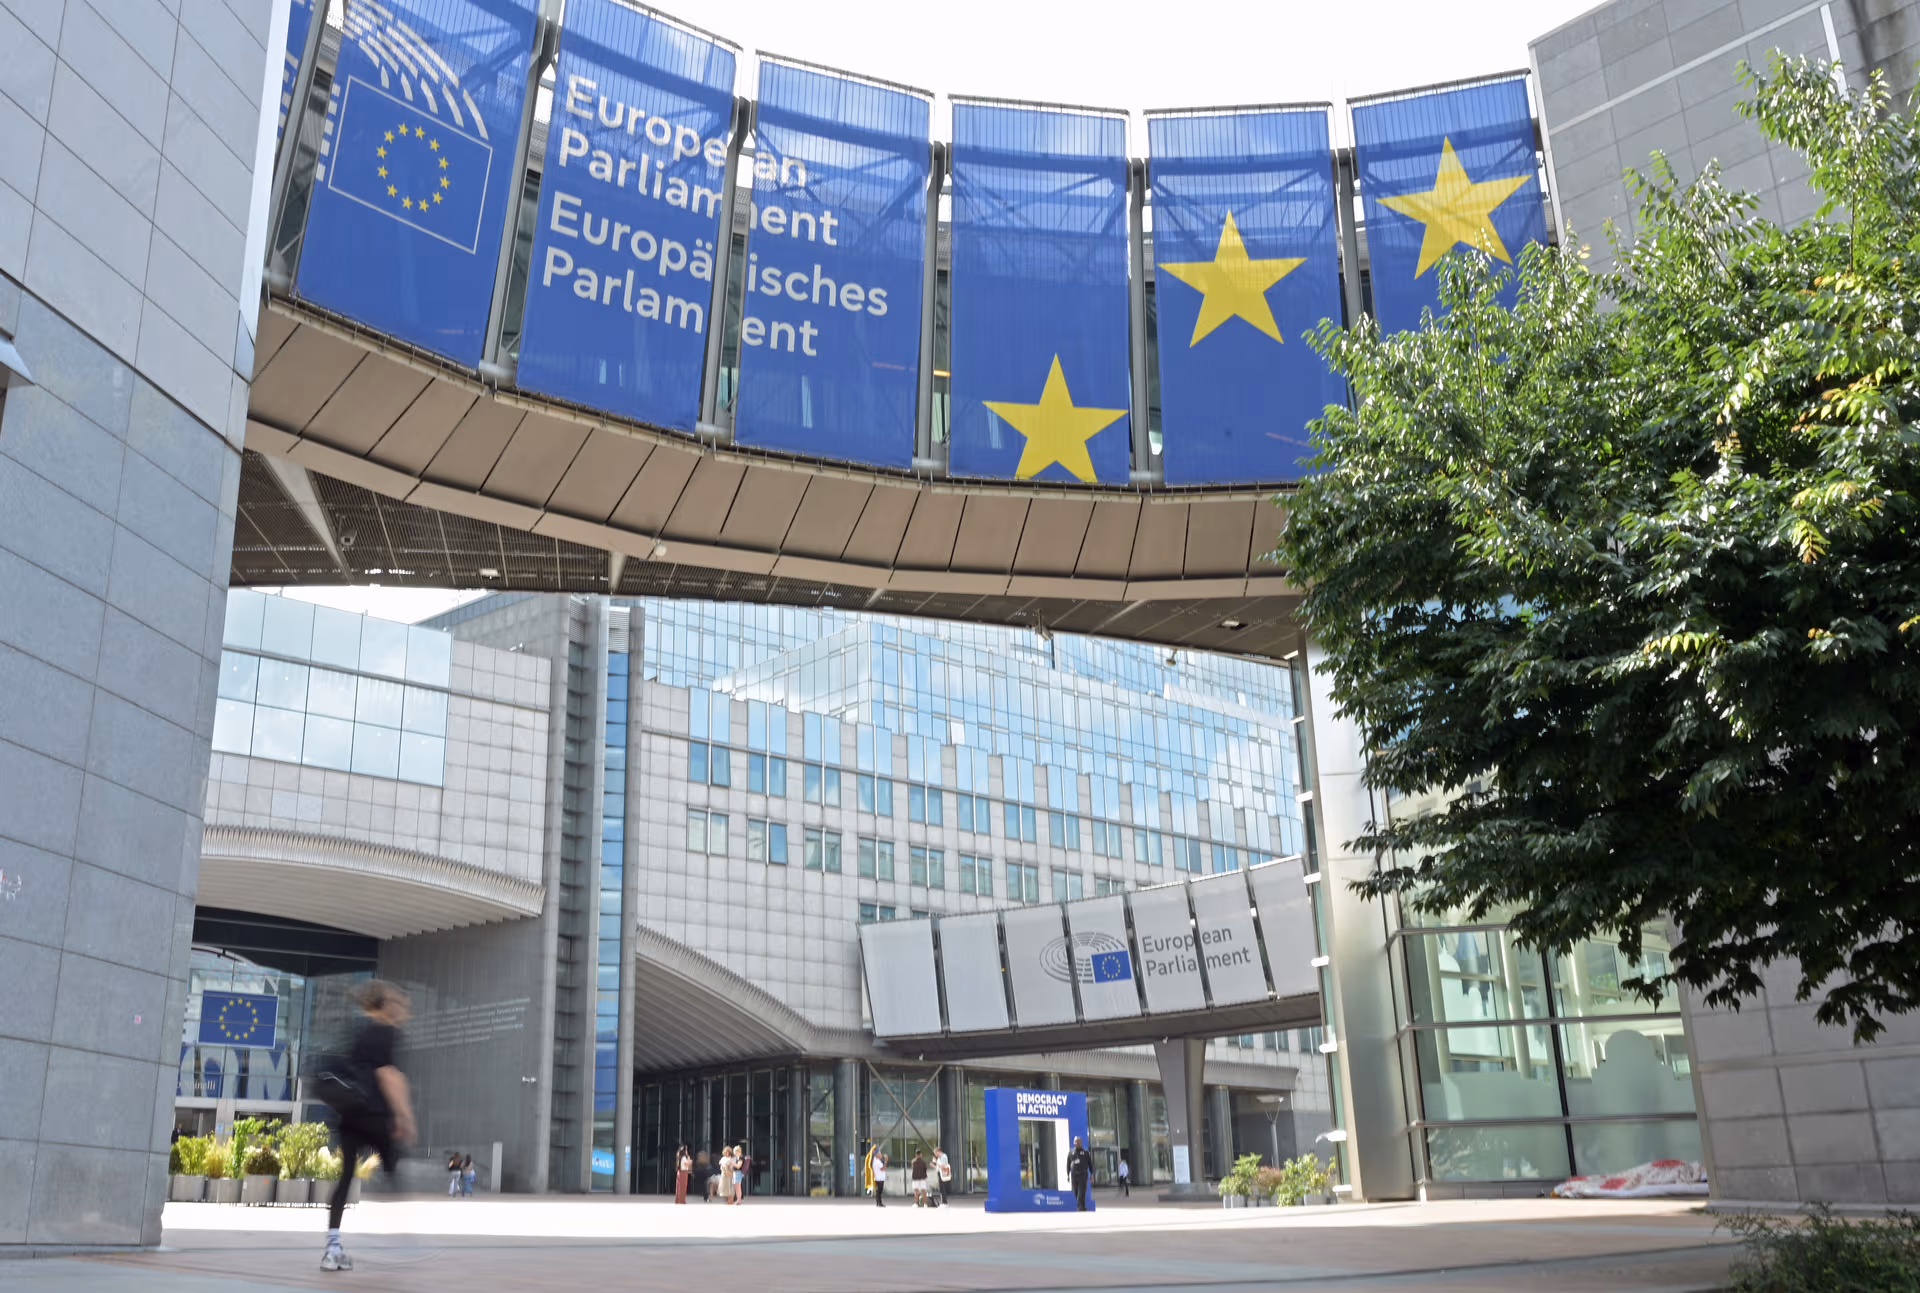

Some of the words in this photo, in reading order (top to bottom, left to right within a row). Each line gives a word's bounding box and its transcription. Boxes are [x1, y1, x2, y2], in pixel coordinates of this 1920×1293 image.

[1142, 928, 1232, 954] European
[1146, 947, 1251, 976] Parliament
[1016, 1093, 1067, 1105] DEMOCRACY
[1017, 1103, 1026, 1114] IN
[1028, 1104, 1058, 1115] ACTION
